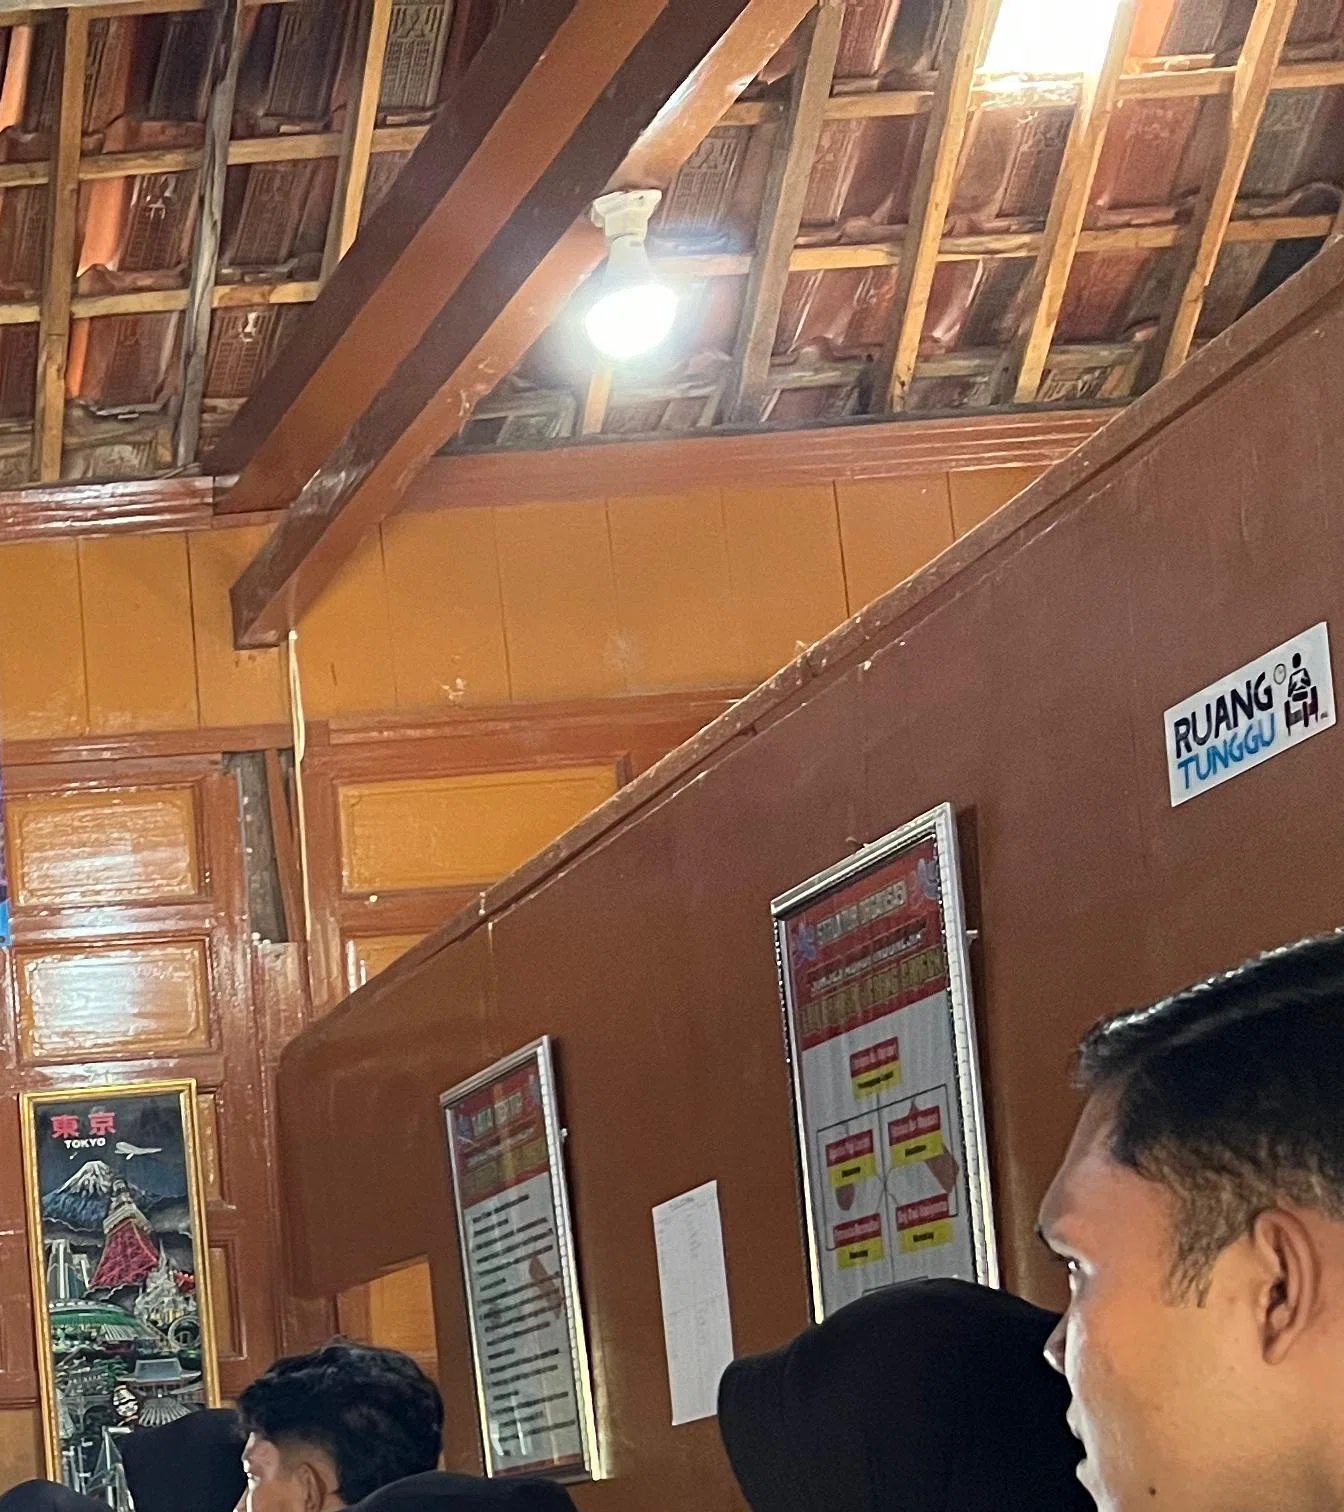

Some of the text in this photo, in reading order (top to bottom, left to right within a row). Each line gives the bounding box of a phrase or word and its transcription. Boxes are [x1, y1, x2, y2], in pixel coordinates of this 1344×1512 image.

[1174, 672, 1274, 758] RUANG
[1177, 712, 1276, 789] TUNGGU
[64, 1137, 106, 1149] TOKYO
